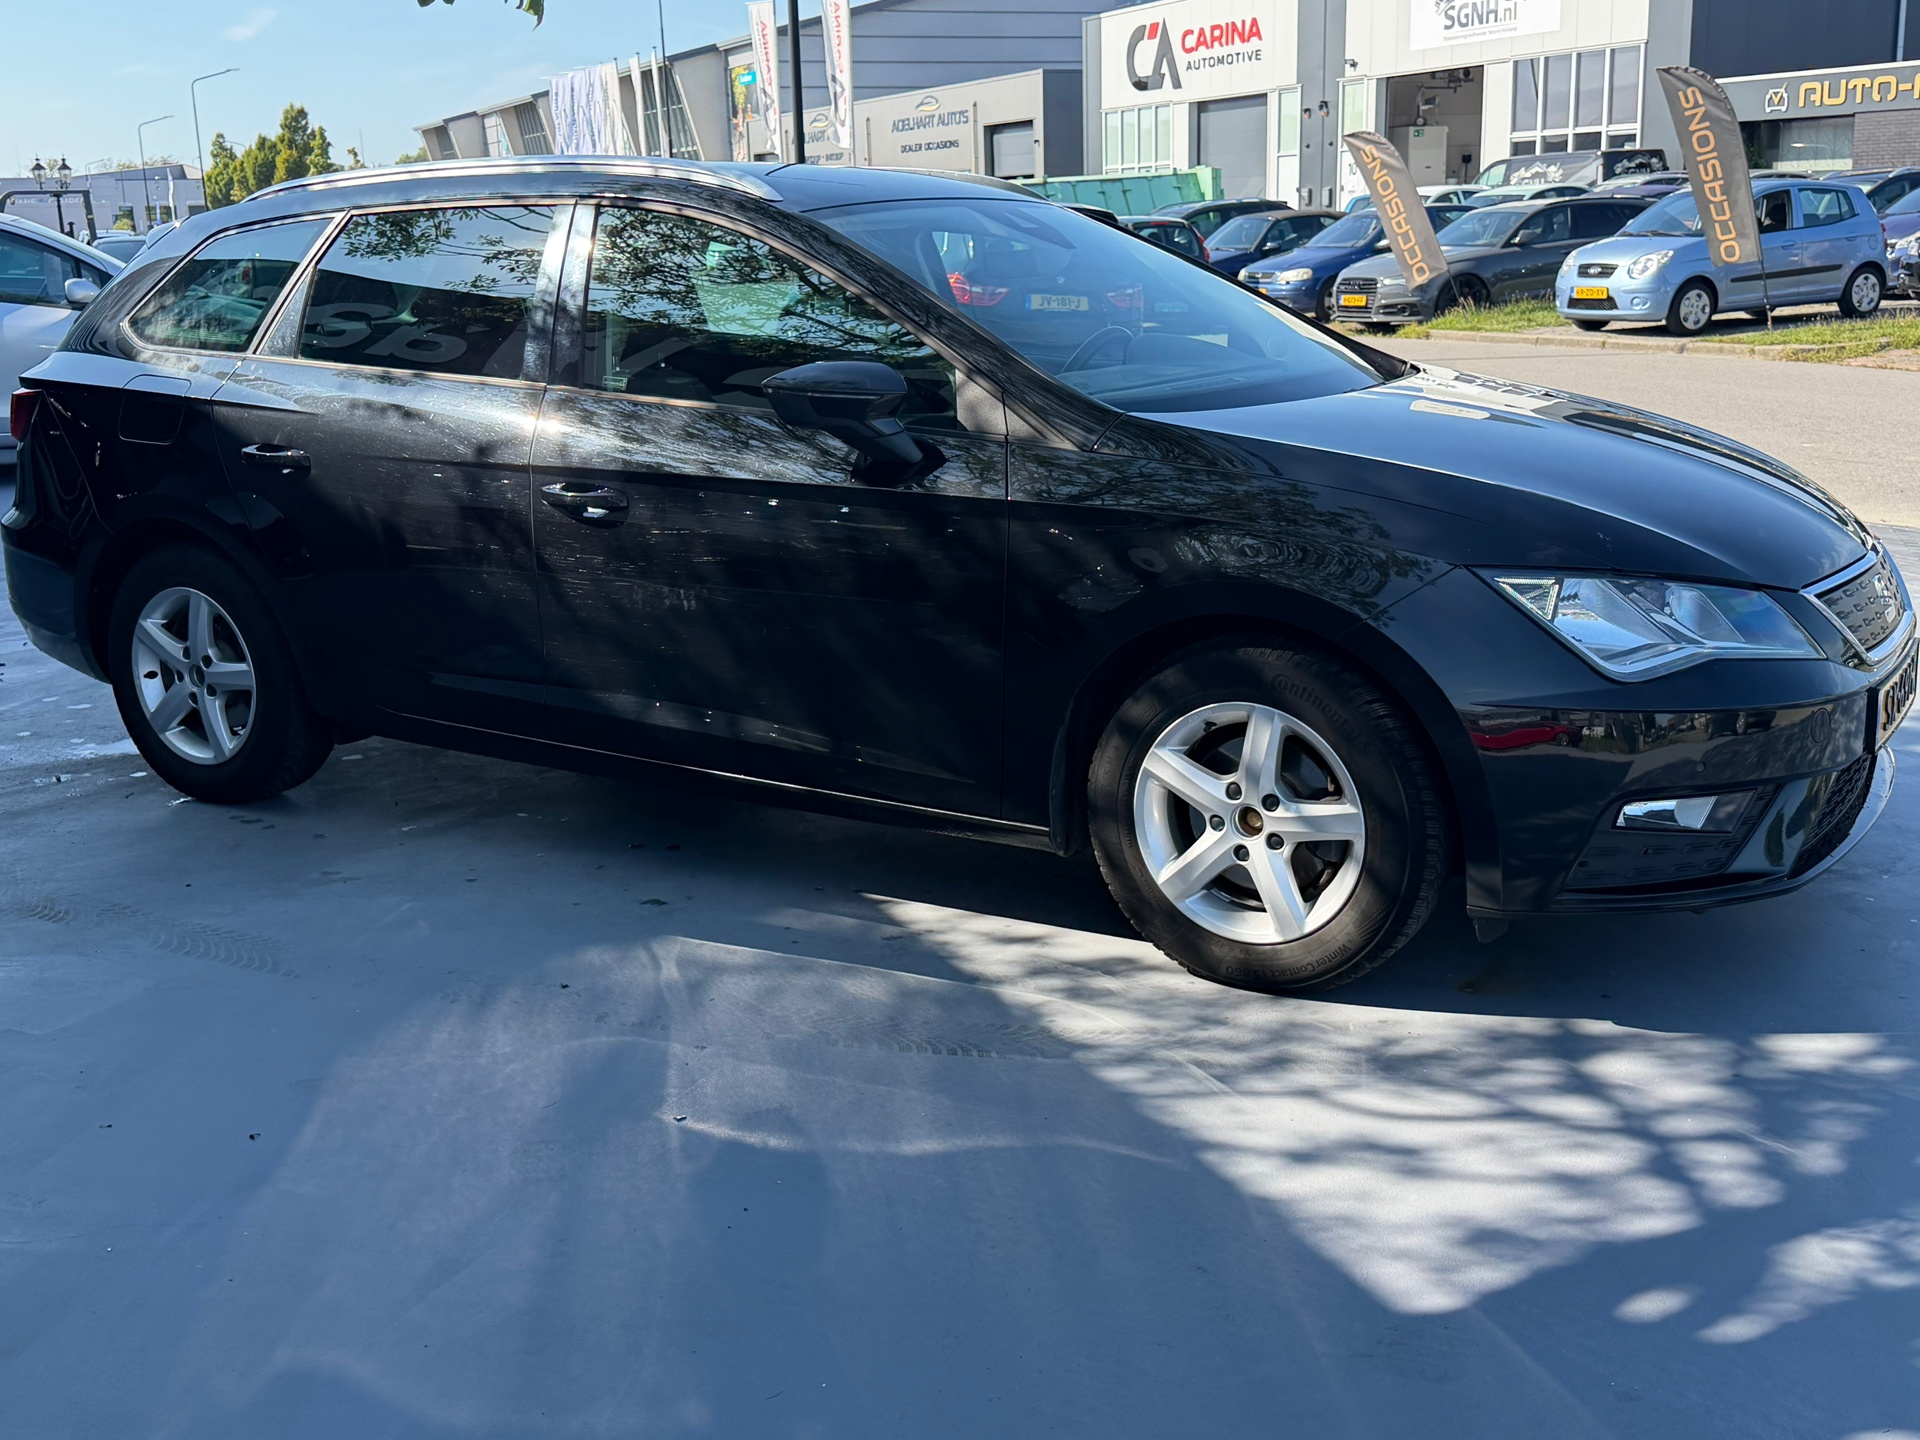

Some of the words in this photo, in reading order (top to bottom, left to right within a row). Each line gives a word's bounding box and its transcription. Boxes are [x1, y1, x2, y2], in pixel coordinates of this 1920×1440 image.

[1443, 0, 1518, 31] SGNH.nl
[1181, 17, 1263, 54] CARINA
[1185, 49, 1262, 72] AUTOMOTIVE
[937, 109, 970, 128] AUTO'S
[901, 142, 923, 154] DEALER
[924, 139, 960, 152] OCCASIONS
[1677, 86, 1741, 263] OCCASIONS
[1359, 144, 1430, 284] OCCASIONS
[1271, 943, 1353, 980] WinterContact
